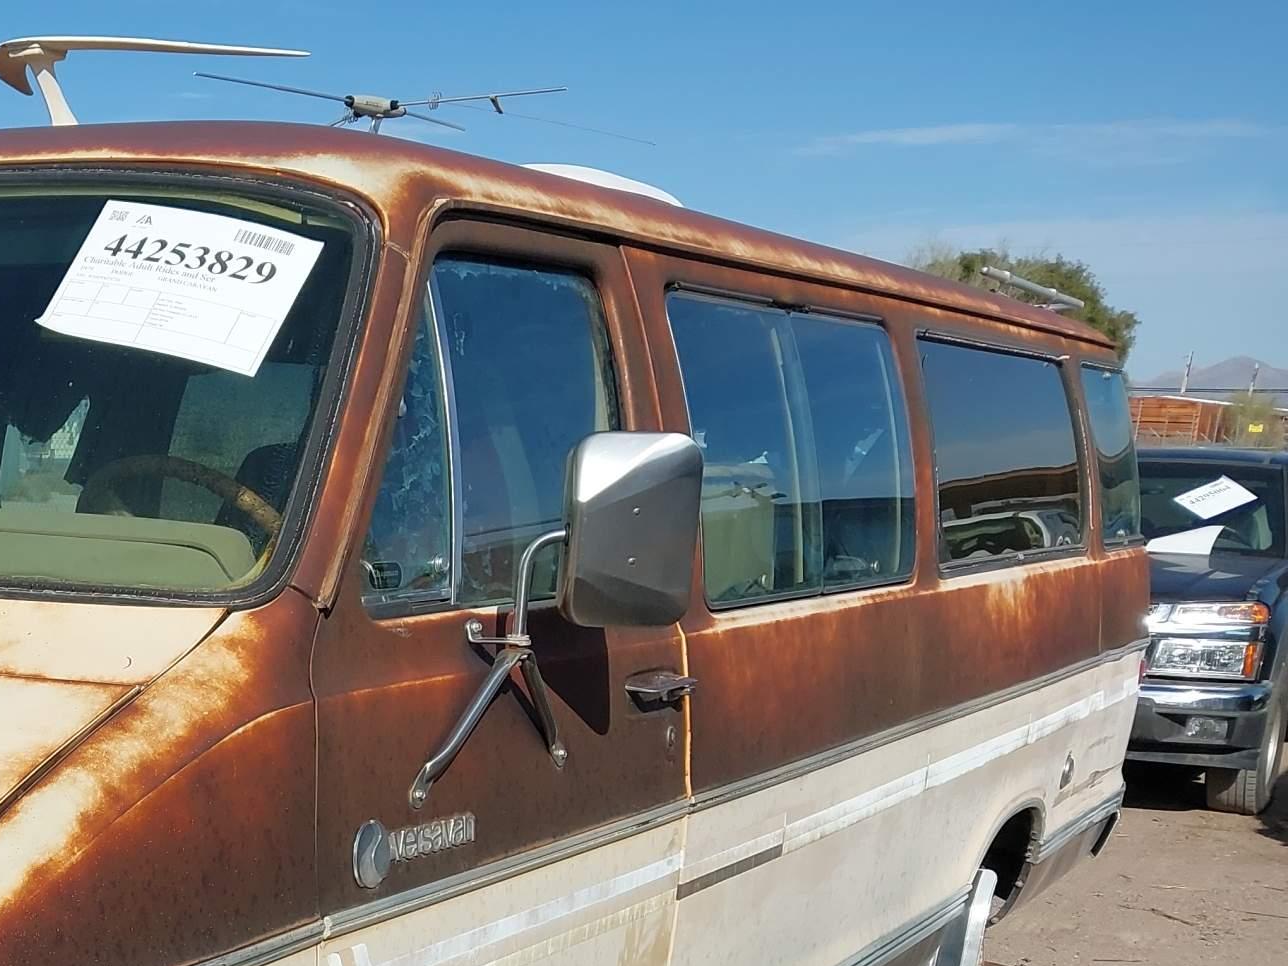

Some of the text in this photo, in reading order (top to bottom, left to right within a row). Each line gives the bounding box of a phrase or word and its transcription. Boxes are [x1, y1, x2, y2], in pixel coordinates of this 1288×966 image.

[83, 255, 128, 269] Charitable
[129, 261, 154, 272] Adult
[155, 265, 181, 276] Rides
[181, 271, 200, 281] and
[200, 273, 217, 284] Ser
[103, 233, 278, 284] 44253829
